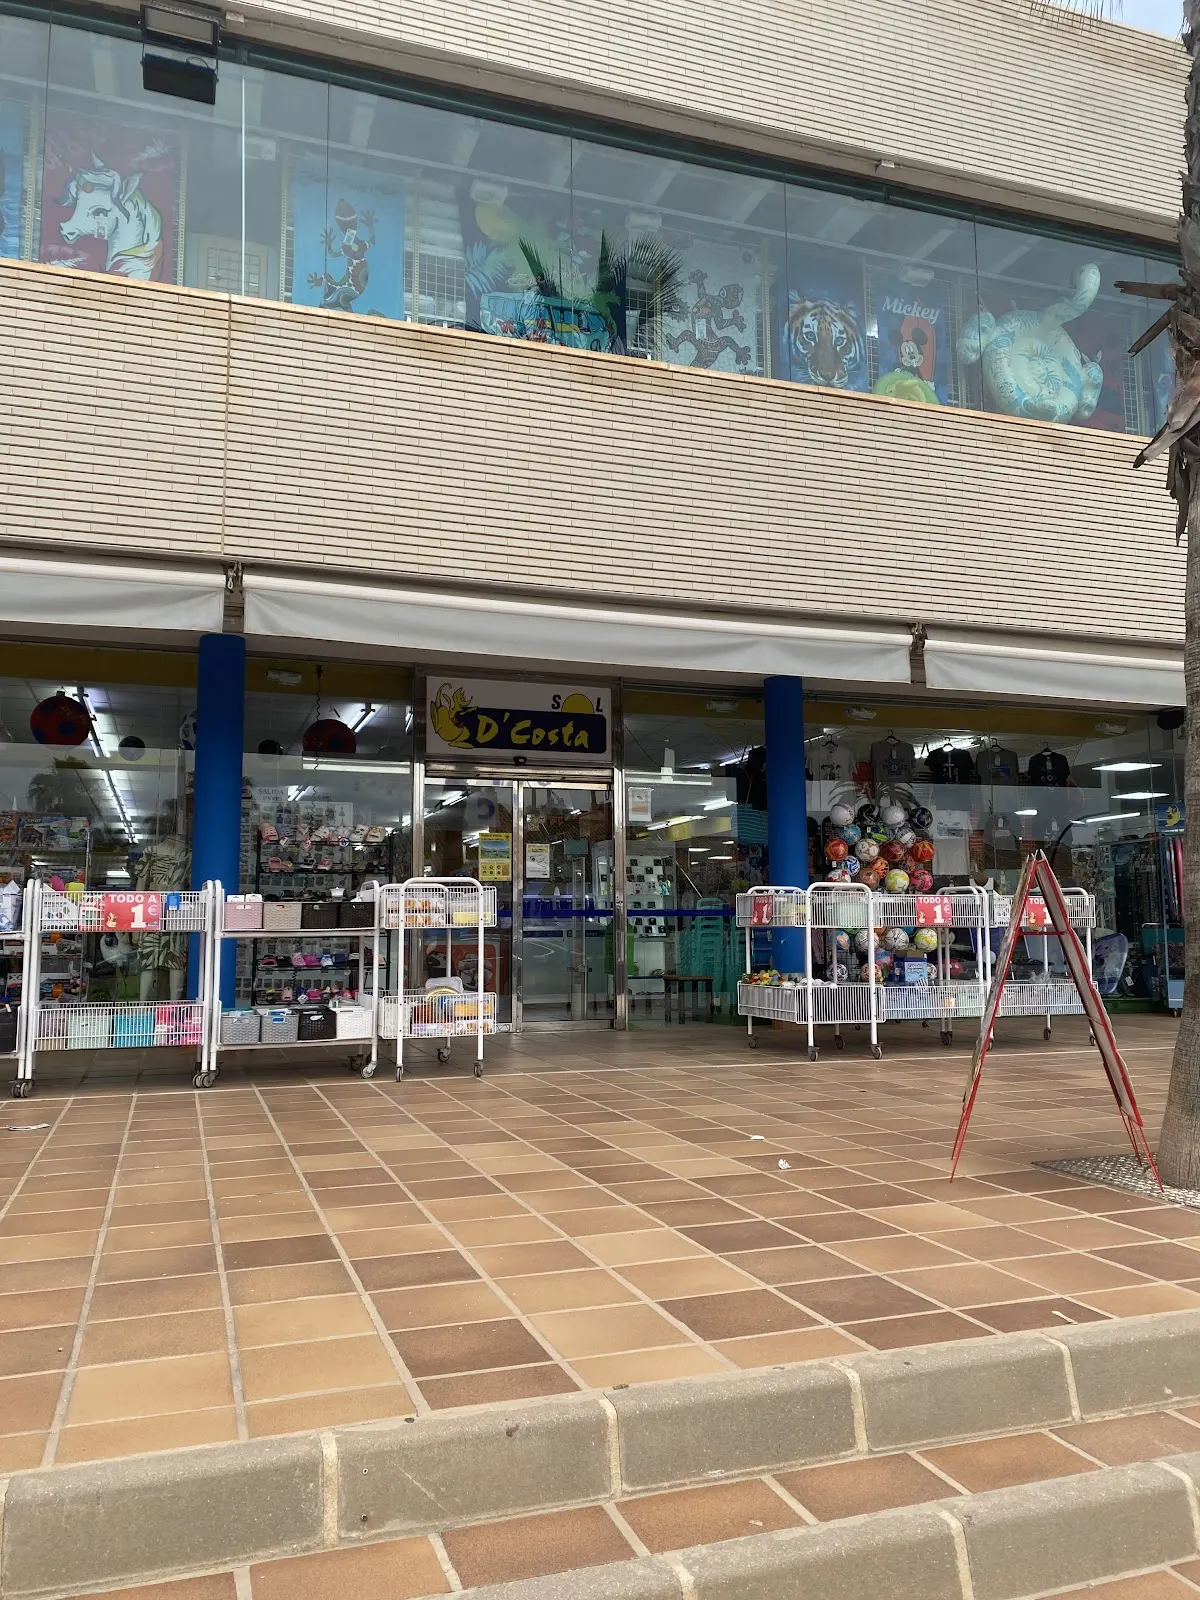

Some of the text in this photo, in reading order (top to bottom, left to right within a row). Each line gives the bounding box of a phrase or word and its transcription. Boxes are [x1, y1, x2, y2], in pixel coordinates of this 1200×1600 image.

[882, 296, 940, 324] Mickey
[258, 787, 284, 795] SALIDA
[108, 894, 157, 903] TODO A
[917, 896, 940, 904] TODO
[1028, 897, 1045, 905] TOD
